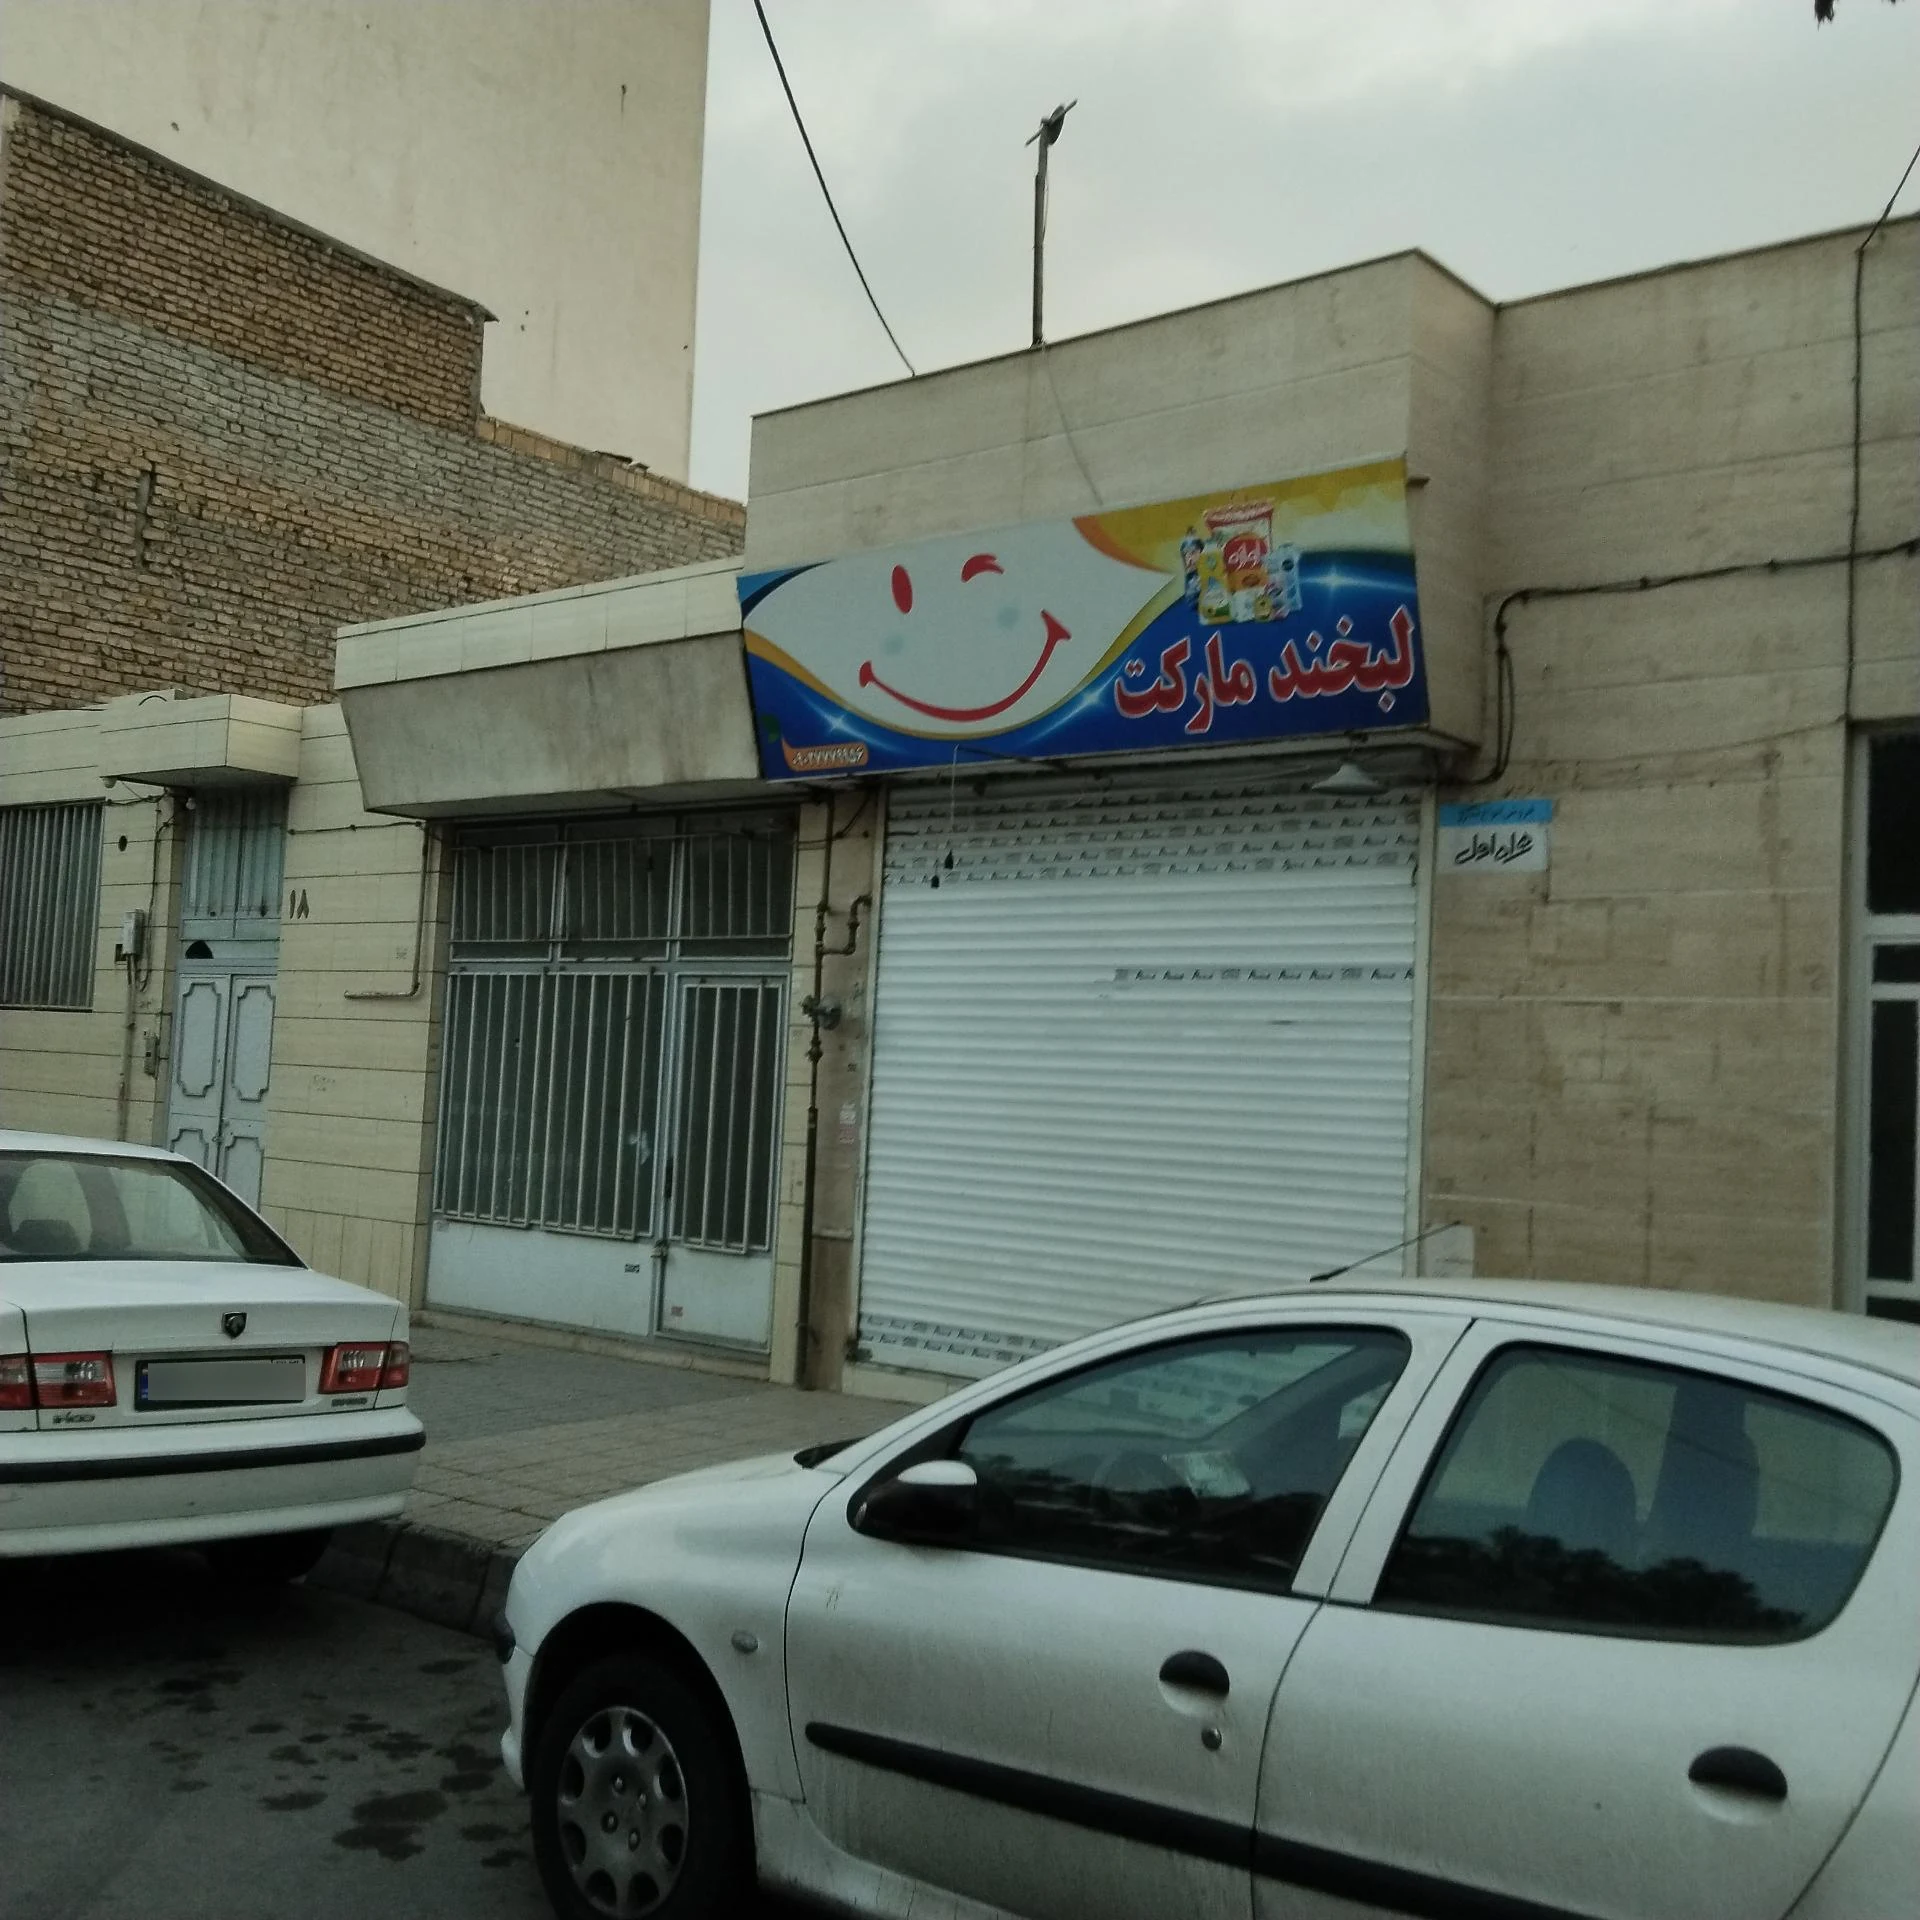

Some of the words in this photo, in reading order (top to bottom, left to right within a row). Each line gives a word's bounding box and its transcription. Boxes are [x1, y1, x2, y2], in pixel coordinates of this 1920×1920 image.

[1268, 604, 1415, 713] لبخند
[1114, 630, 1257, 735] مارکت
[1454, 832, 1497, 865] اول
[1494, 831, 1535, 865] همراه
[290, 889, 310, 920] ۱۸
